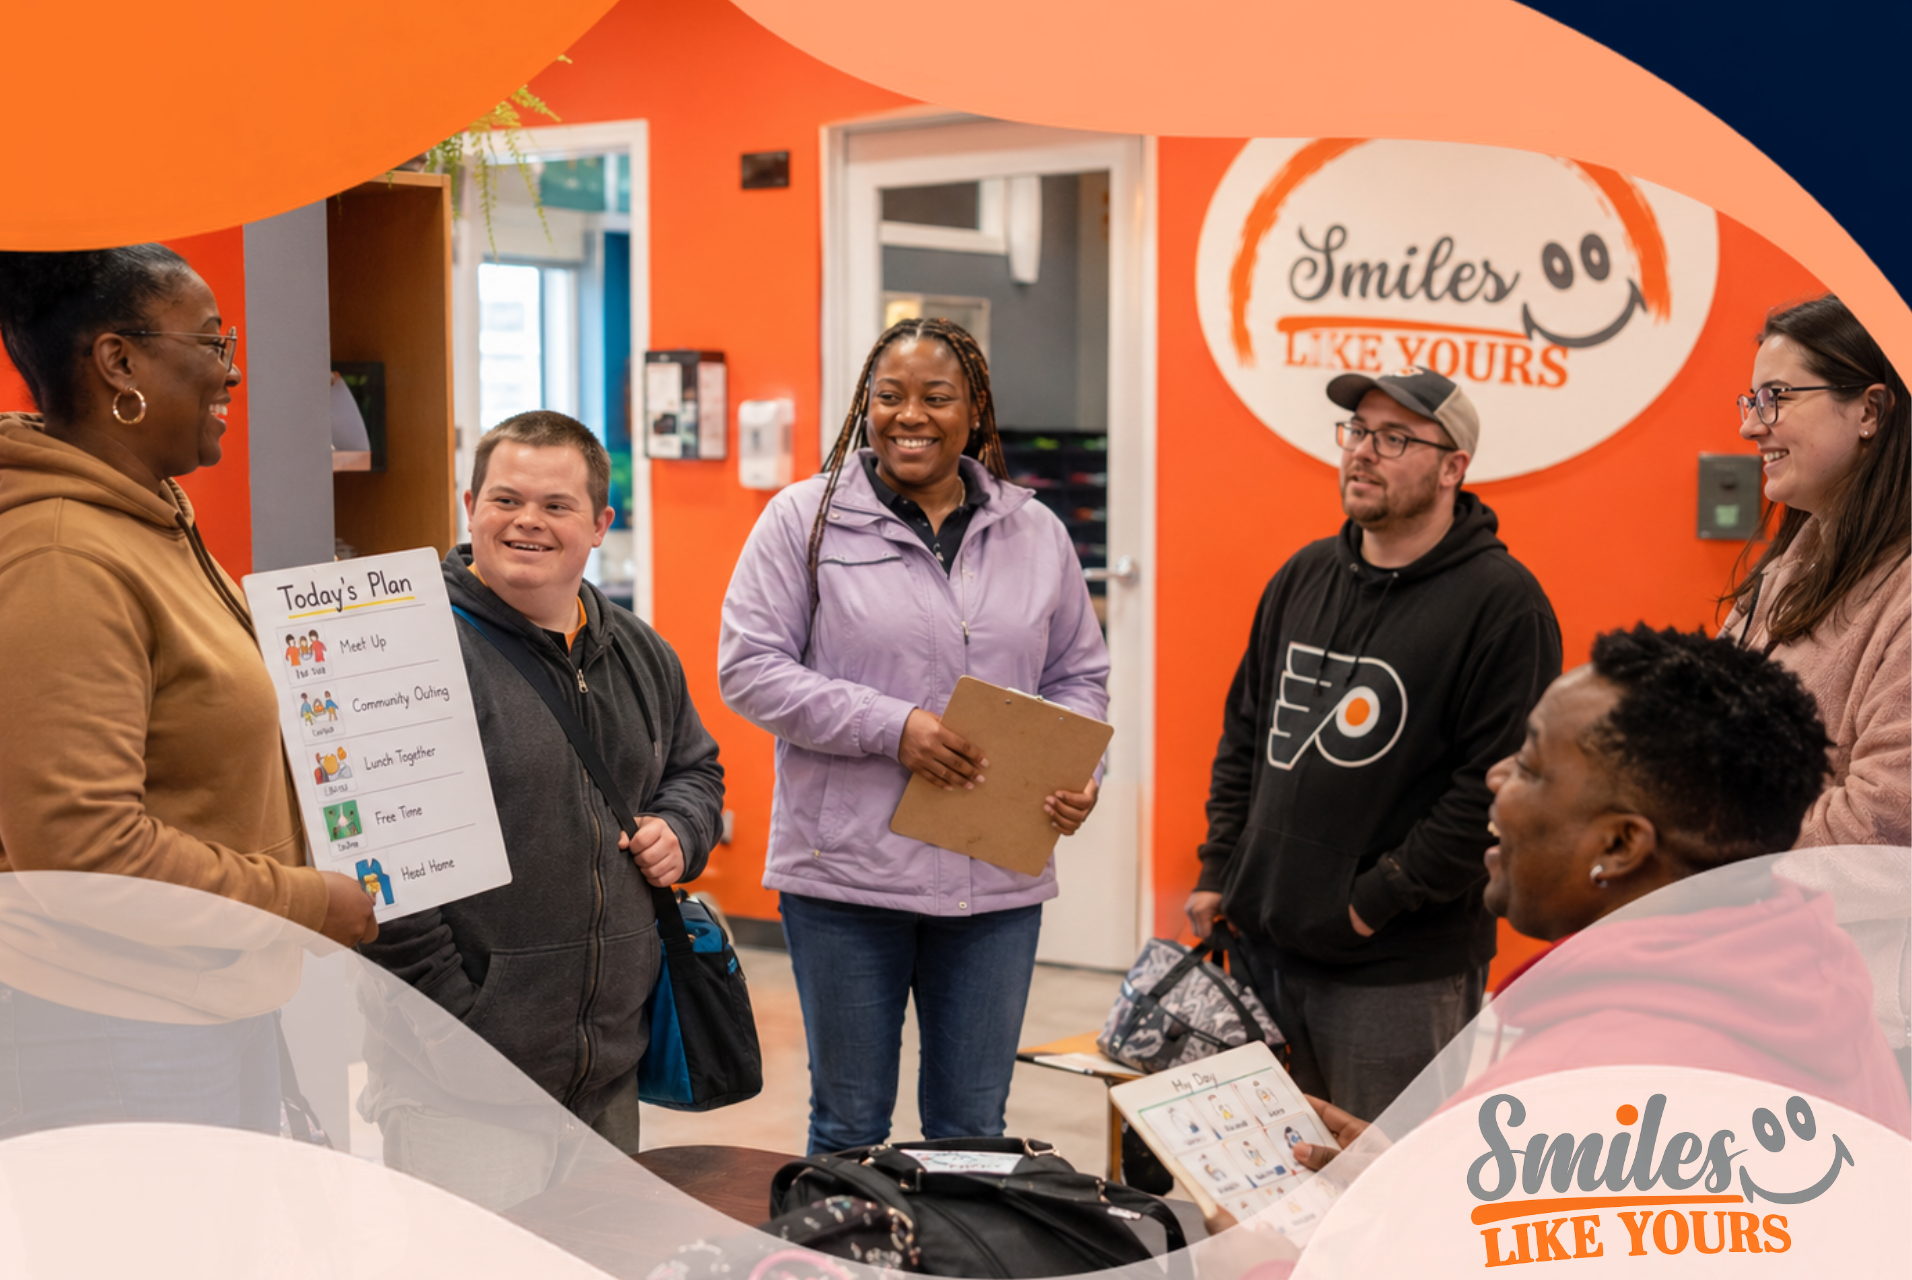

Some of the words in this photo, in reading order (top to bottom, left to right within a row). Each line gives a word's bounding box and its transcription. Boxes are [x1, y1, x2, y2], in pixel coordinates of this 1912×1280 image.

[1289, 224, 1520, 303] Smiles
[1285, 327, 1383, 372] LIKE
[1395, 335, 1570, 389] YOURS
[277, 577, 357, 612] Today's
[367, 570, 412, 597] Plan
[340, 637, 366, 654] Meet
[371, 634, 386, 651] Up
[352, 691, 409, 712] Community
[414, 685, 450, 702] Outing
[364, 753, 393, 770] Lunch
[395, 746, 436, 766] Together
[375, 810, 397, 825] Free
[398, 805, 423, 819] Time
[428, 858, 455, 873] Home
[1171, 1079, 1194, 1094] My
[1191, 1072, 1218, 1088] Day
